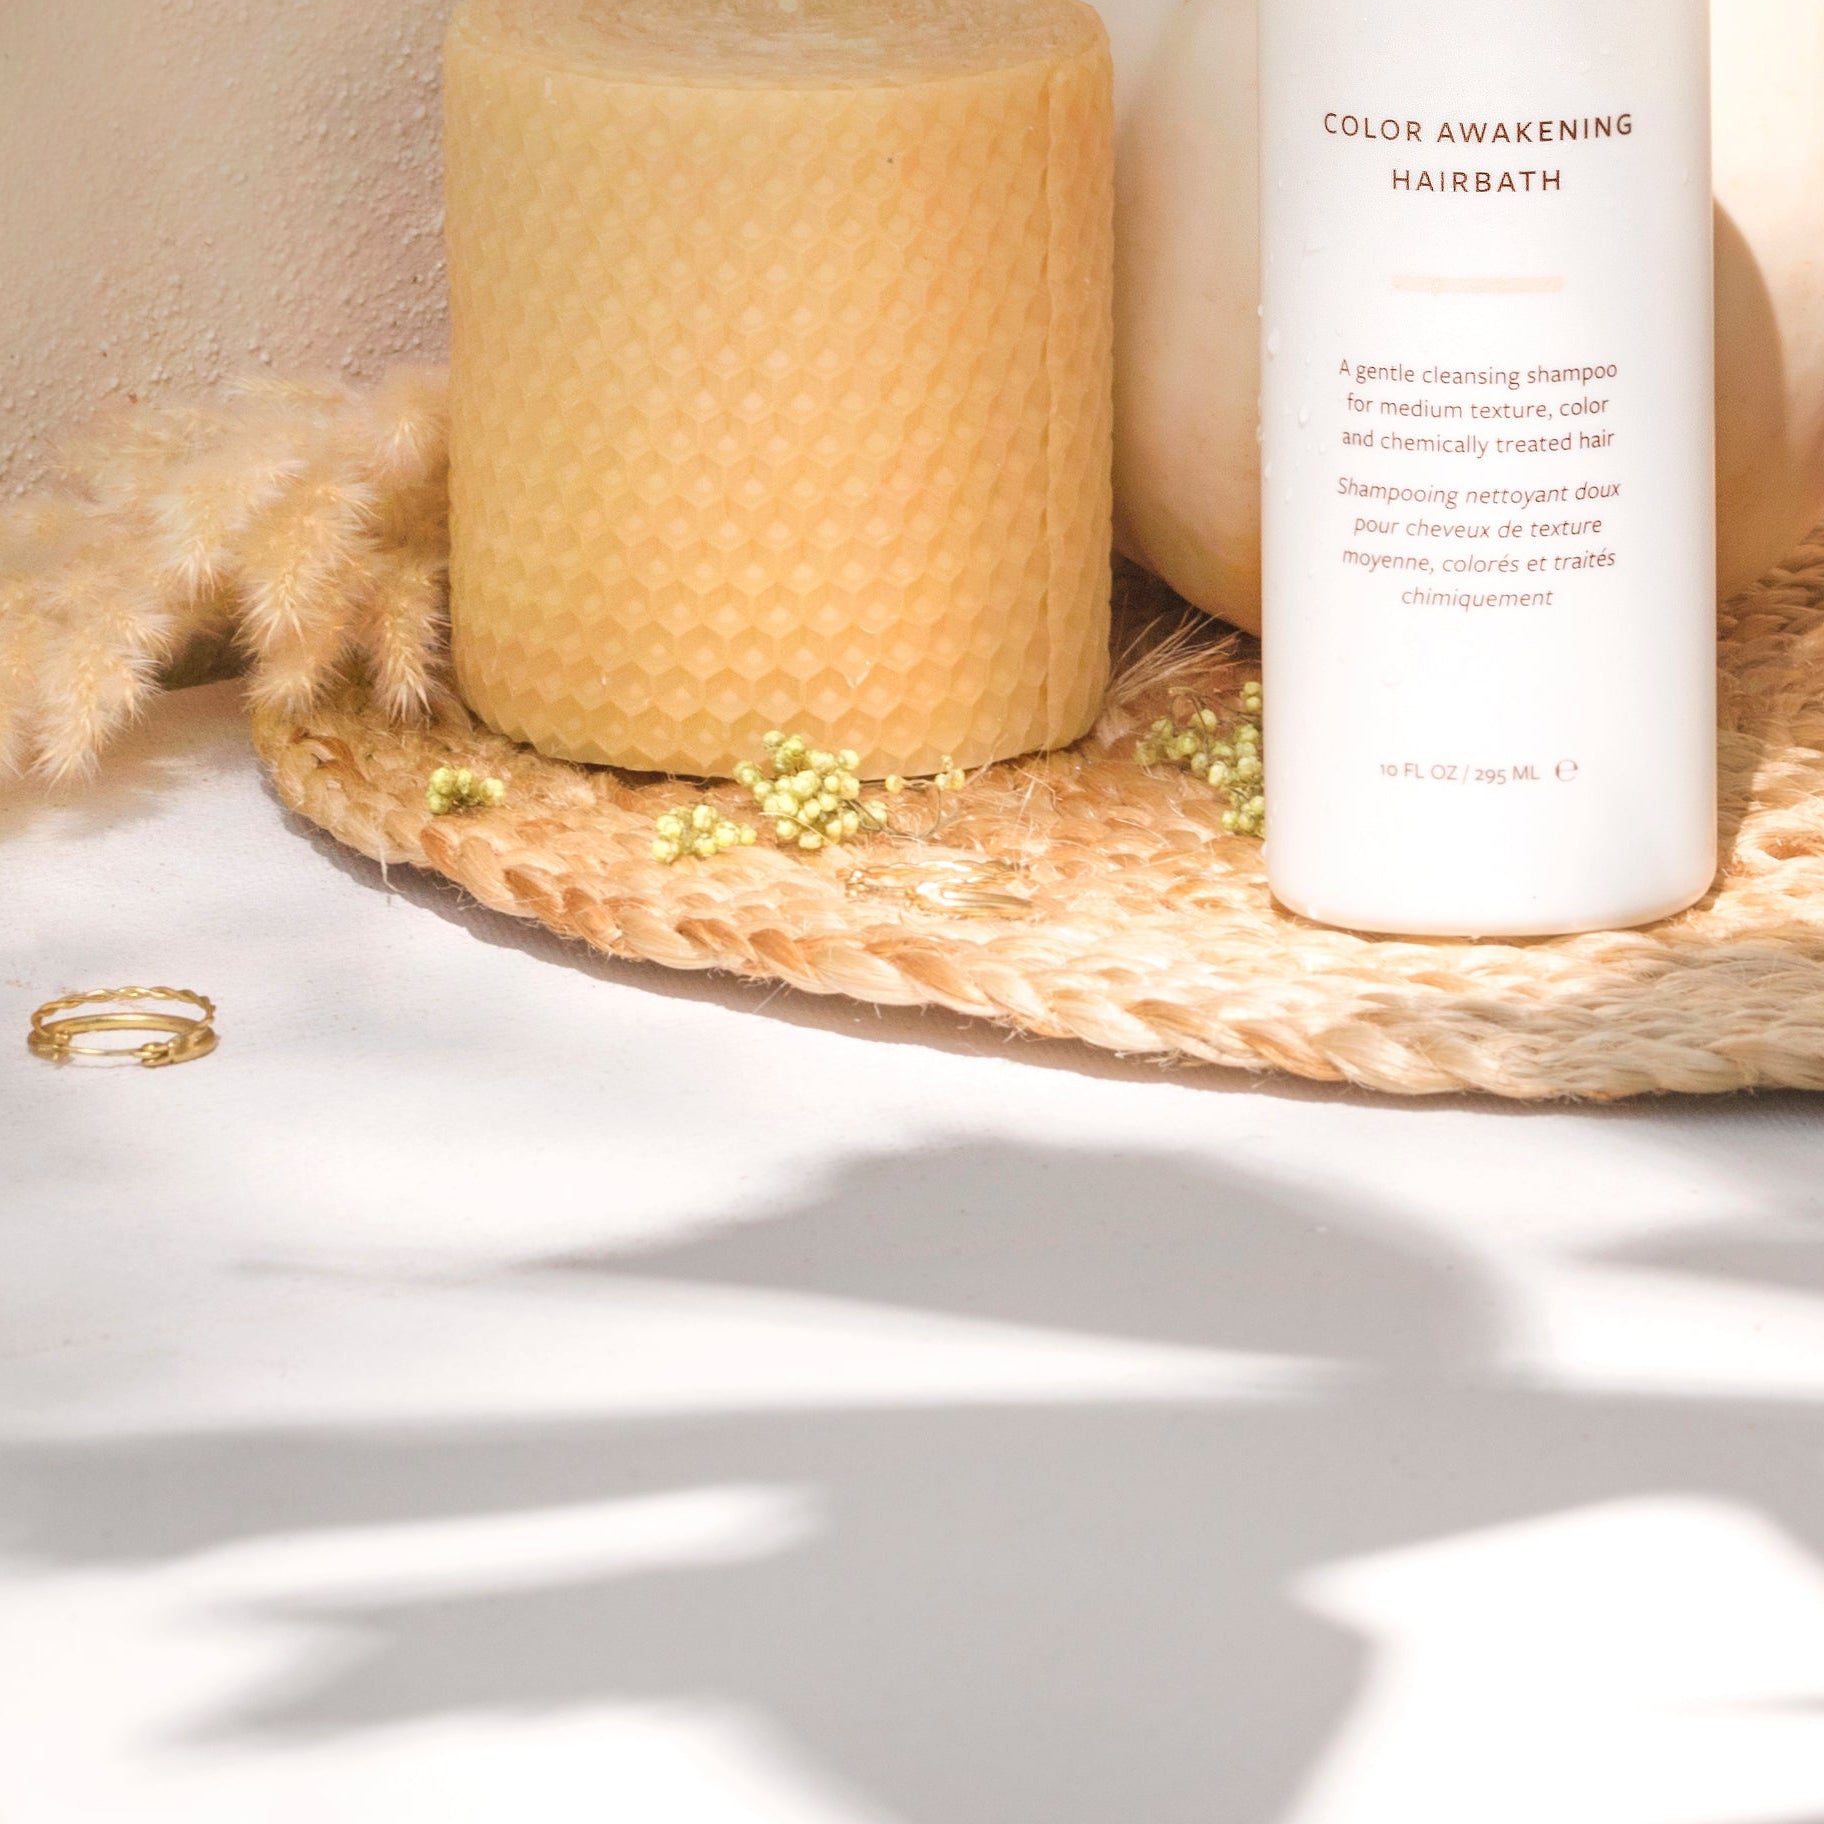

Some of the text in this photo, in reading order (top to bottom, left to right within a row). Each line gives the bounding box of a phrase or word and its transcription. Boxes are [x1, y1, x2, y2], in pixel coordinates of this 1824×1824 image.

[1324, 113, 1631, 143] COLOR AWAKENING
[1393, 169, 1560, 192] HAIRBATH
[1339, 359, 1617, 391] A gentle cleansing shampoo
[1347, 392, 1609, 420] for medium texture, color
[1342, 429, 1615, 459] and chemically treated hair
[1337, 477, 1620, 510] Shampooing nettoyant doux
[1354, 518, 1602, 539] pour cheveux de texture
[1343, 548, 1615, 574] moyenne, colorés et traités
[1401, 587, 1554, 612] chimiquement
[1380, 764, 1399, 777] 10
[1403, 762, 1424, 779] FL
[1430, 764, 1458, 781] OZ
[1474, 769, 1507, 785] 295
[1512, 765, 1540, 780] ML
